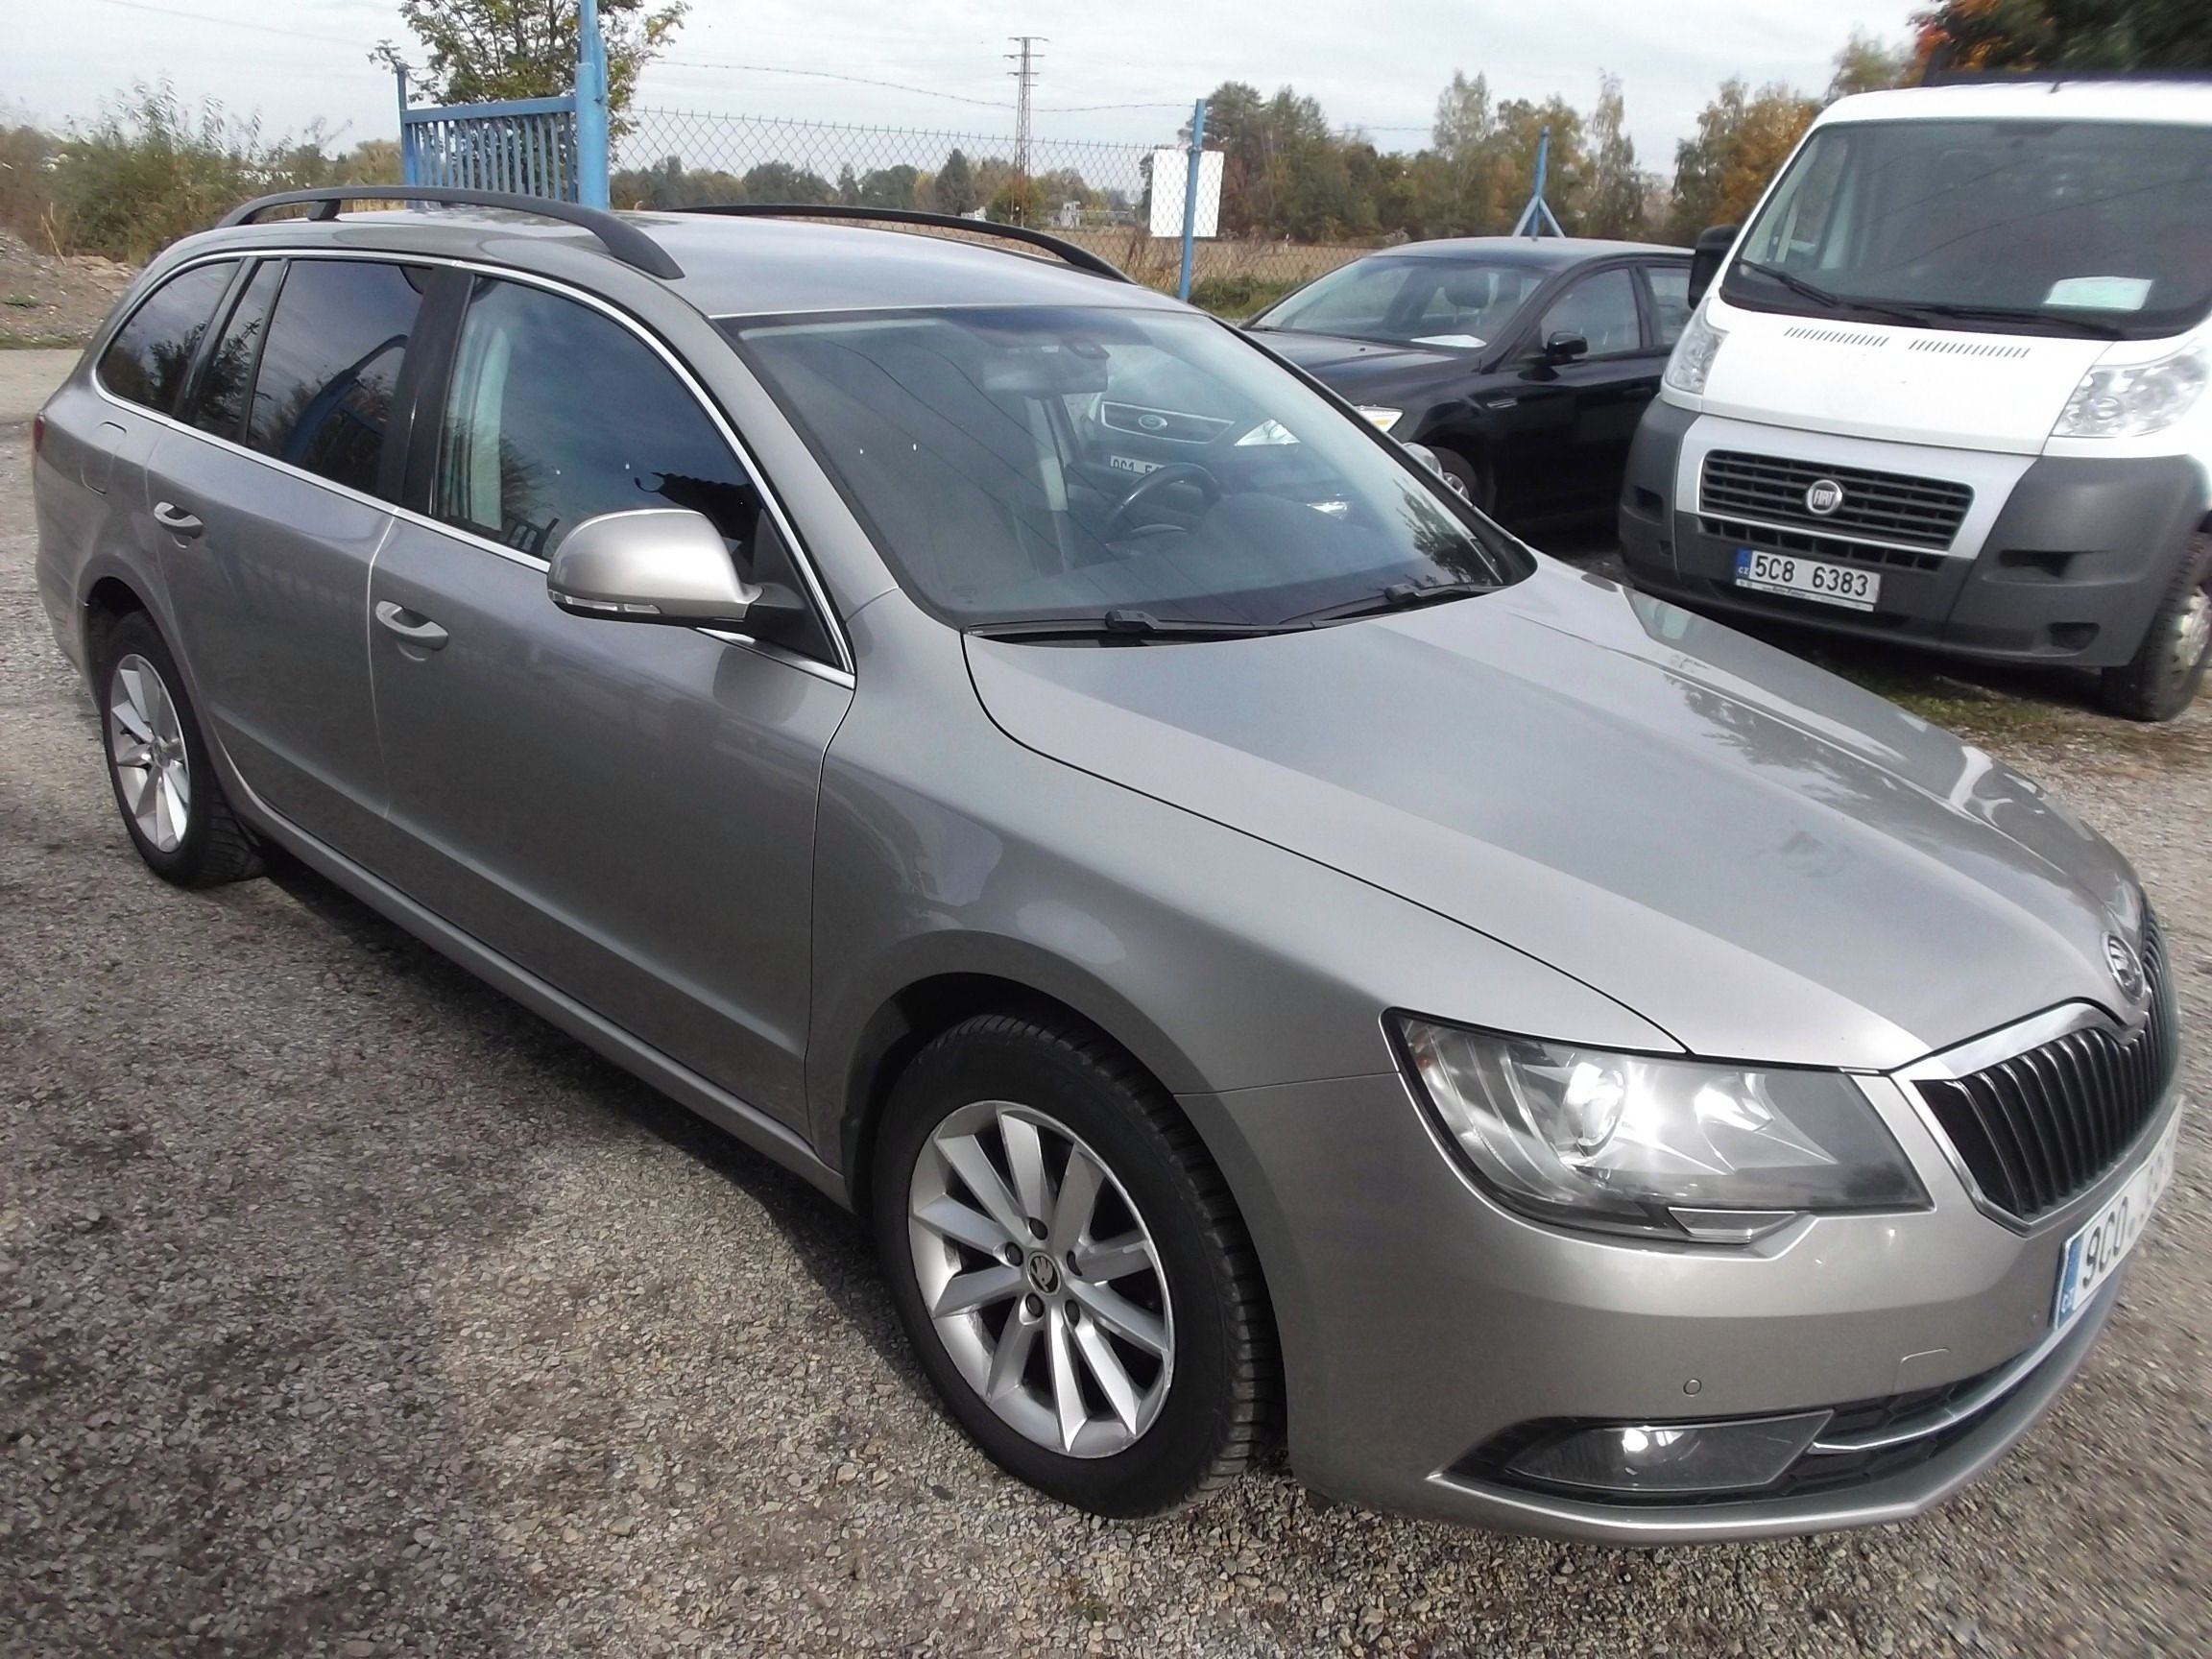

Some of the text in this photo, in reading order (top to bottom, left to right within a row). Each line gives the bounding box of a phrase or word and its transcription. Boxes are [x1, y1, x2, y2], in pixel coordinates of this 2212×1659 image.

[1813, 490, 1835, 506] FIAT
[1755, 555, 1795, 583] 5C8
[1812, 565, 1868, 597] 6383
